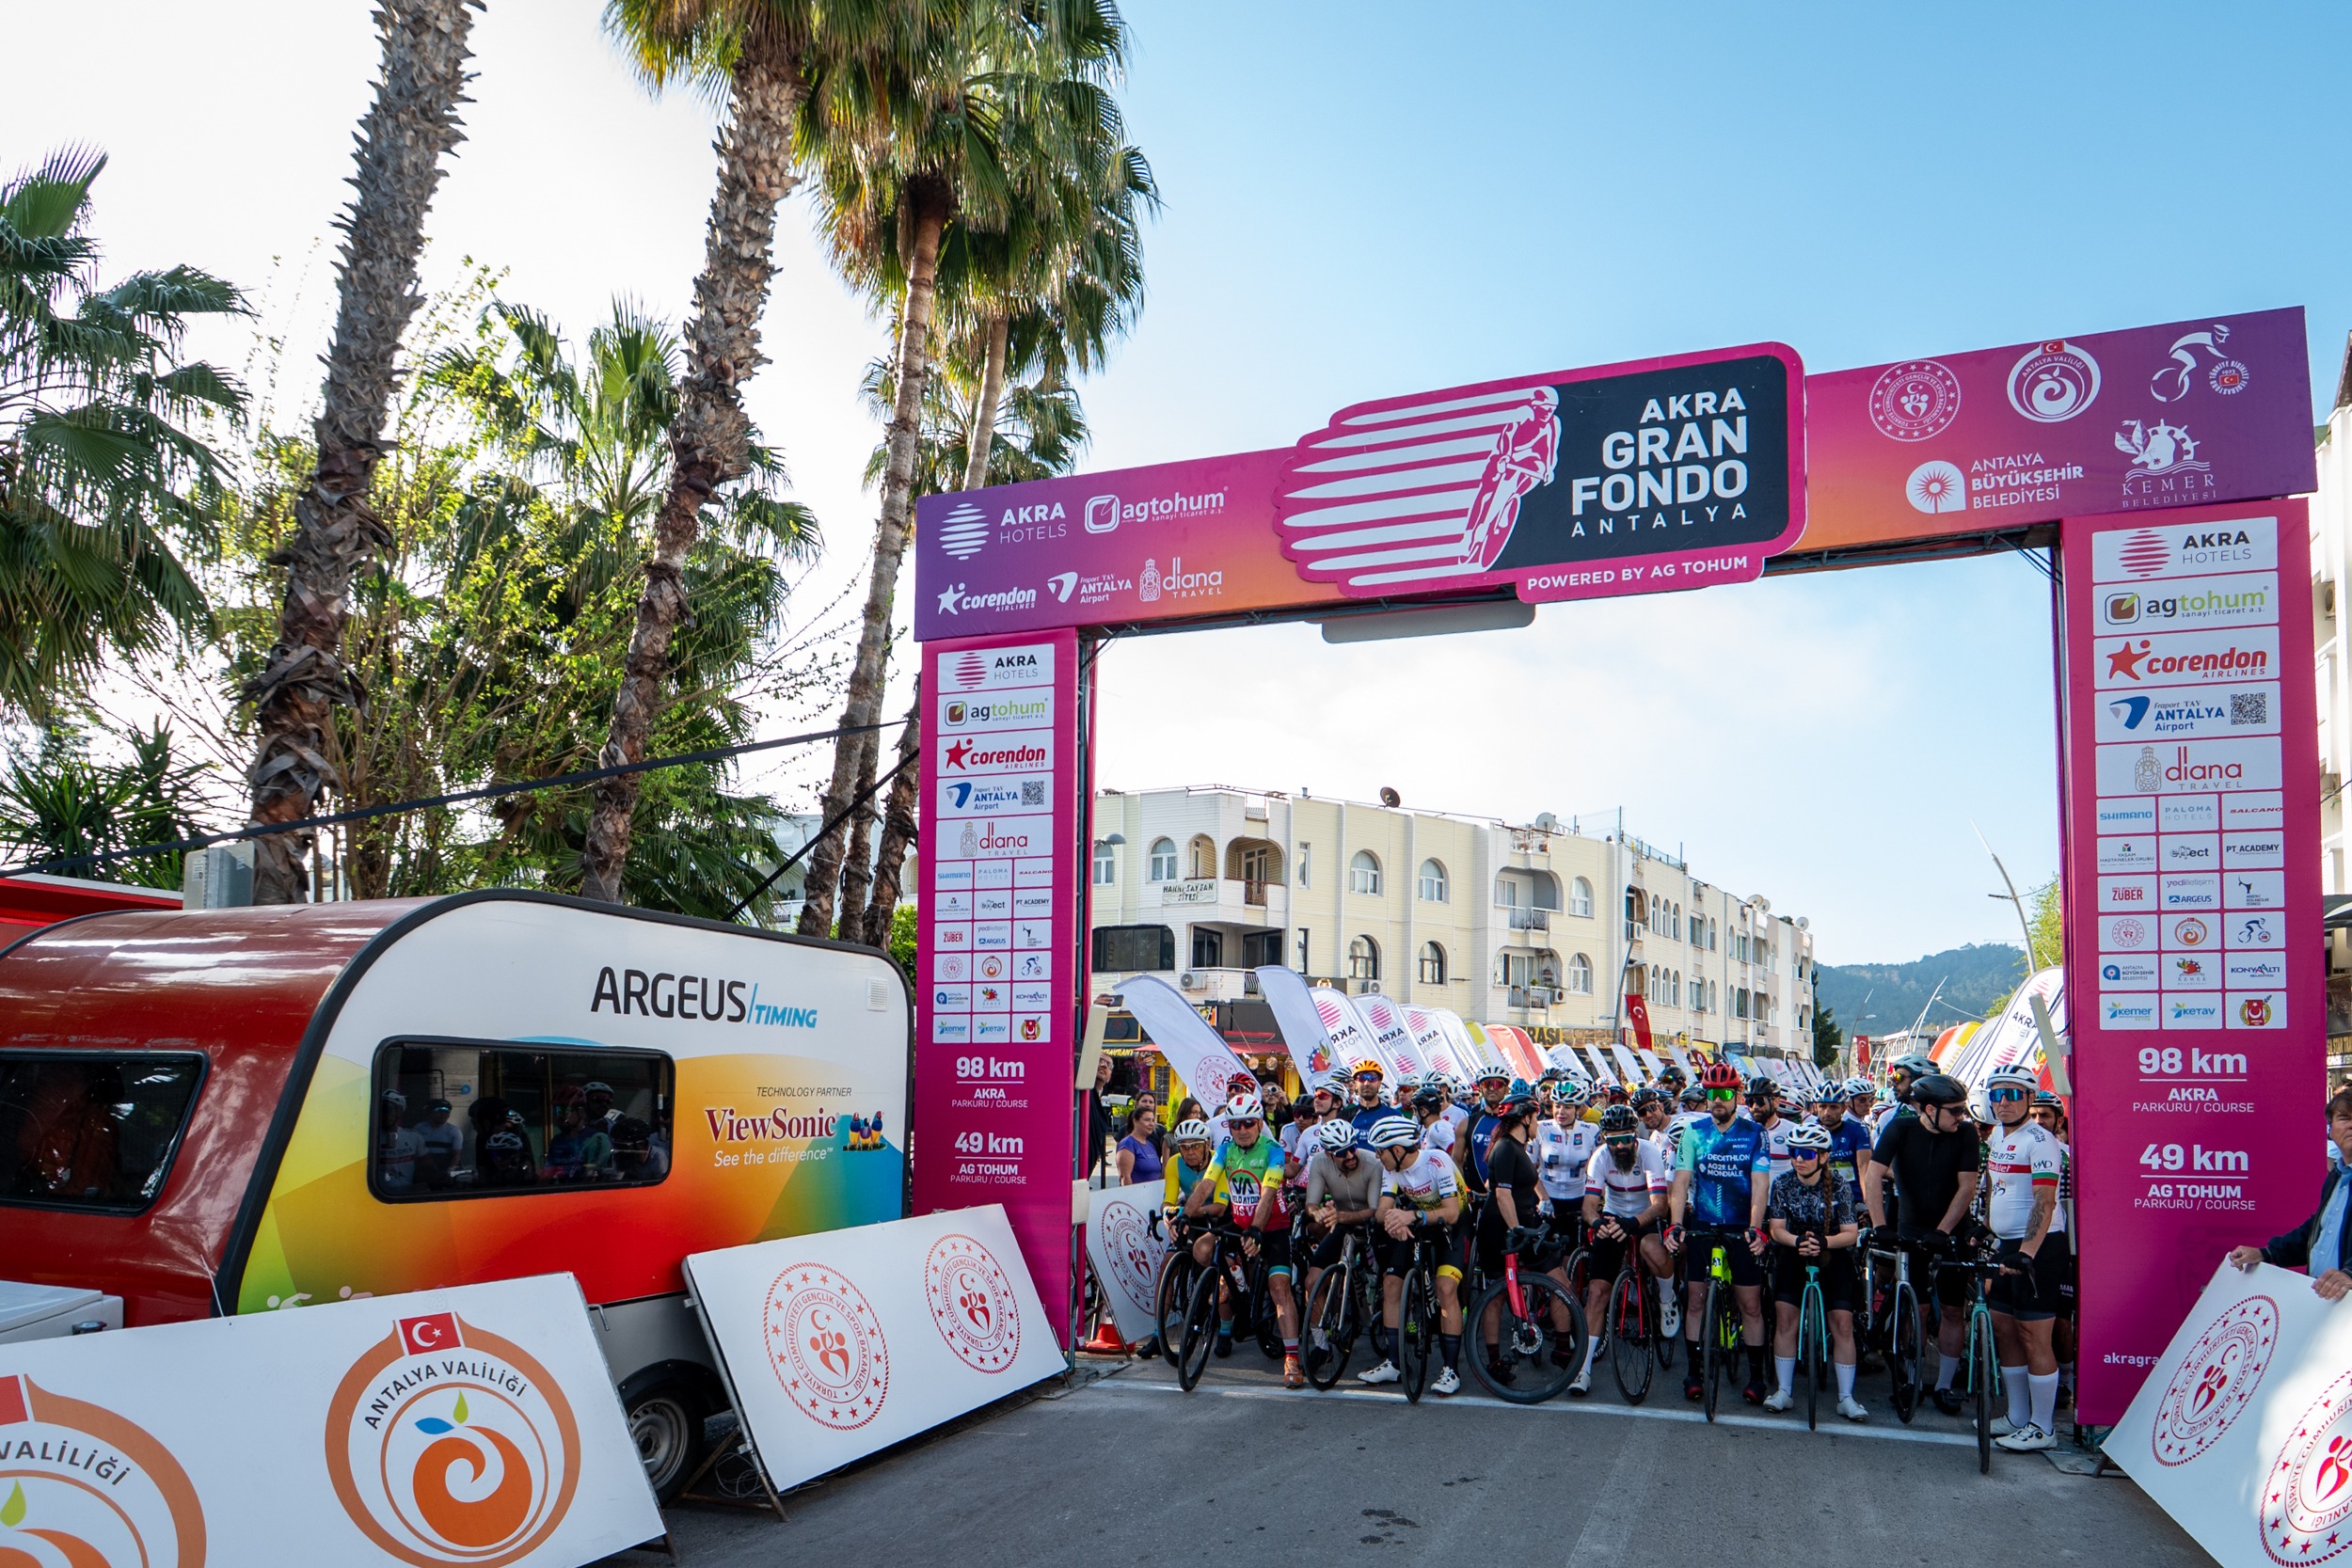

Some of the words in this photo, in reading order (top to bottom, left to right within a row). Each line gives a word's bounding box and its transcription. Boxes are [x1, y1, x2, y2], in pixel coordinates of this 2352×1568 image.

[2023, 357, 2051, 377] ANTALYA
[2054, 356, 2085, 370] VALİLİĞİ
[1640, 388, 1746, 424] AKRA
[1602, 415, 1748, 470] GRAN
[1971, 451, 2044, 472] ANTALYA
[1572, 460, 1748, 515] FONDO
[1972, 463, 2084, 491] BÜYÜKŞEHİR
[2122, 474, 2215, 496] KEMER
[1121, 491, 1224, 522] agtohum
[1973, 485, 2060, 509] BELEDİYESİ
[2122, 490, 2217, 507] BELEDİYESİ
[1000, 502, 1066, 526] AKRA
[1572, 503, 1747, 537] ANTALYA
[1000, 523, 1067, 544] HOTELS
[2183, 531, 2249, 549] AKRA
[2183, 548, 2251, 564] HOTELS
[1528, 572, 1615, 591] POWERED
[1621, 568, 1645, 582] BY
[1651, 564, 1677, 579] AG
[1681, 556, 1748, 577] TOHUM
[1080, 578, 1132, 595] ANTALYA
[1173, 588, 1222, 598] TRAVEL
[961, 586, 1036, 610] corendon
[995, 602, 1035, 612] AIRLINES
[1080, 594, 1109, 604] Airport
[2147, 591, 2265, 618] agtohum
[2182, 610, 2210, 618] sanayi
[2215, 607, 2246, 615] ticaret
[994, 655, 1037, 668] AKRA
[2147, 647, 2266, 673] corendon
[994, 668, 1038, 680] HOTELS
[2202, 668, 2265, 678] AIRLINES
[971, 701, 1045, 721] agtohum
[2154, 707, 2224, 721] ANTALYA
[2154, 721, 2194, 733] Airport
[971, 745, 1045, 765] corendon
[2179, 781, 2243, 791] TRAVEL
[975, 792, 1018, 802] ANTALYA
[2100, 811, 2153, 820] SHIMANO
[591, 966, 746, 1022] ARGEUS
[956, 1056, 984, 1077] 98
[990, 1057, 1025, 1077] km
[2138, 1047, 2182, 1074] 98
[2192, 1047, 2247, 1073] km
[756, 1086, 815, 1098] TECHNOLOGY
[817, 1087, 852, 1098] PARTNER
[974, 1088, 1006, 1099] AKRA
[2168, 1087, 2218, 1101] AKRA
[996, 1100, 1028, 1108] COURSE
[2133, 1102, 2192, 1112] PARKURU
[2203, 1102, 2254, 1113] COURSE
[705, 1107, 836, 1142] ViewSonic
[955, 1132, 983, 1152] 49
[989, 1132, 1024, 1153] km
[714, 1148, 739, 1167] See
[743, 1148, 765, 1165] the
[2139, 1144, 2184, 1170] 49
[2193, 1145, 2249, 1170] km
[950, 1175, 988, 1183] PARKURU
[960, 1164, 975, 1175] AG
[977, 1164, 1018, 1175] TOHUM
[2148, 1184, 2172, 1197] AG
[2176, 1185, 2241, 1198] TOHUM
[2135, 1199, 2193, 1209] PARKURU
[2205, 1200, 2256, 1210] COURSE
[952, 1259, 977, 1269] GENÇLİK
[978, 1266, 985, 1275] VE
[802, 1291, 834, 1303] GENÇLİK
[942, 1265, 957, 1323] CUMHURİYETİ
[986, 1275, 998, 1300] SPOR
[835, 1301, 846, 1312] VE
[846, 1311, 863, 1338] SPOR
[994, 1300, 1005, 1342] BAKANLIĞI
[787, 1299, 804, 1370] CUMHURİYETİ
[957, 1324, 983, 1348] TÜRKİYE
[2236, 1325, 2256, 1346] GENÇLİK
[854, 1339, 868, 1391] BAKANLIĞI
[2185, 1325, 2236, 1385] CUMHURİYETİ
[2246, 1349, 2253, 1361] VE
[803, 1371, 837, 1399] TÜRKİYE
[2233, 1363, 2250, 1394] SPOR
[364, 1363, 439, 1430] ANTALYA
[442, 1360, 528, 1400] VALİLİĞİ
[2173, 1389, 2185, 1427] TÜRKİYE
[2186, 1396, 2232, 1435] BAKANLIĞI
[2288, 1463, 2304, 1513] TÜRKİYE
